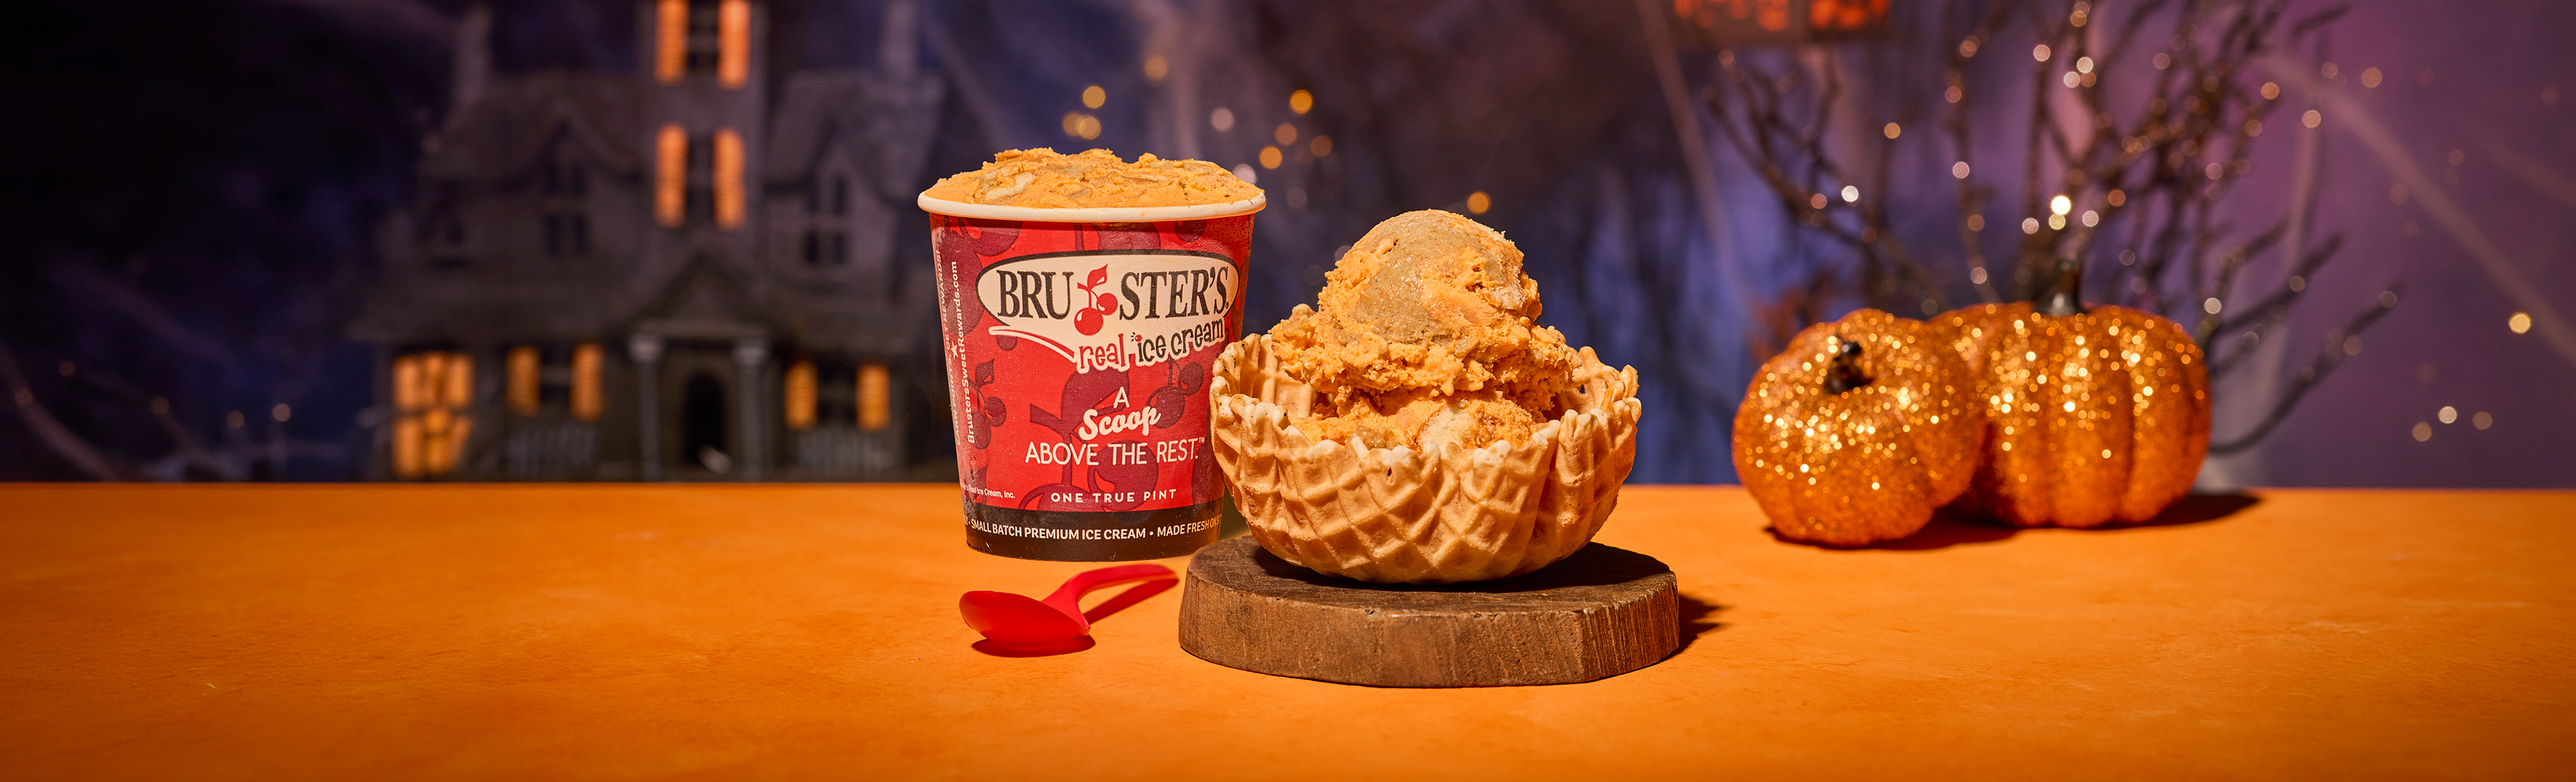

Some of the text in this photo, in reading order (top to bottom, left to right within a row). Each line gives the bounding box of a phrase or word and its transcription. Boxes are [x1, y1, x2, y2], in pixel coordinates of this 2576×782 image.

[951, 261, 975, 444] BrustersSweetRewards.com
[1080, 318, 1224, 369] real ice cream
[1113, 386, 1130, 408] A
[1078, 406, 1161, 440] Scoop
[1025, 441, 1099, 466] ABOVE
[1107, 442, 1148, 465] THE
[984, 488, 1003, 499] Cream,
[1004, 490, 1015, 499] Inc.
[1051, 489, 1176, 503] ONE TRUE PINT
[971, 518, 992, 533] SMALL
[992, 523, 1022, 537] BATCH
[1024, 527, 1080, 540] PREMIUM
[1082, 529, 1101, 540] ICE
[1103, 528, 1146, 540] CREAM
[1157, 524, 1185, 537] MADE
[1186, 518, 1210, 534] FRESH
